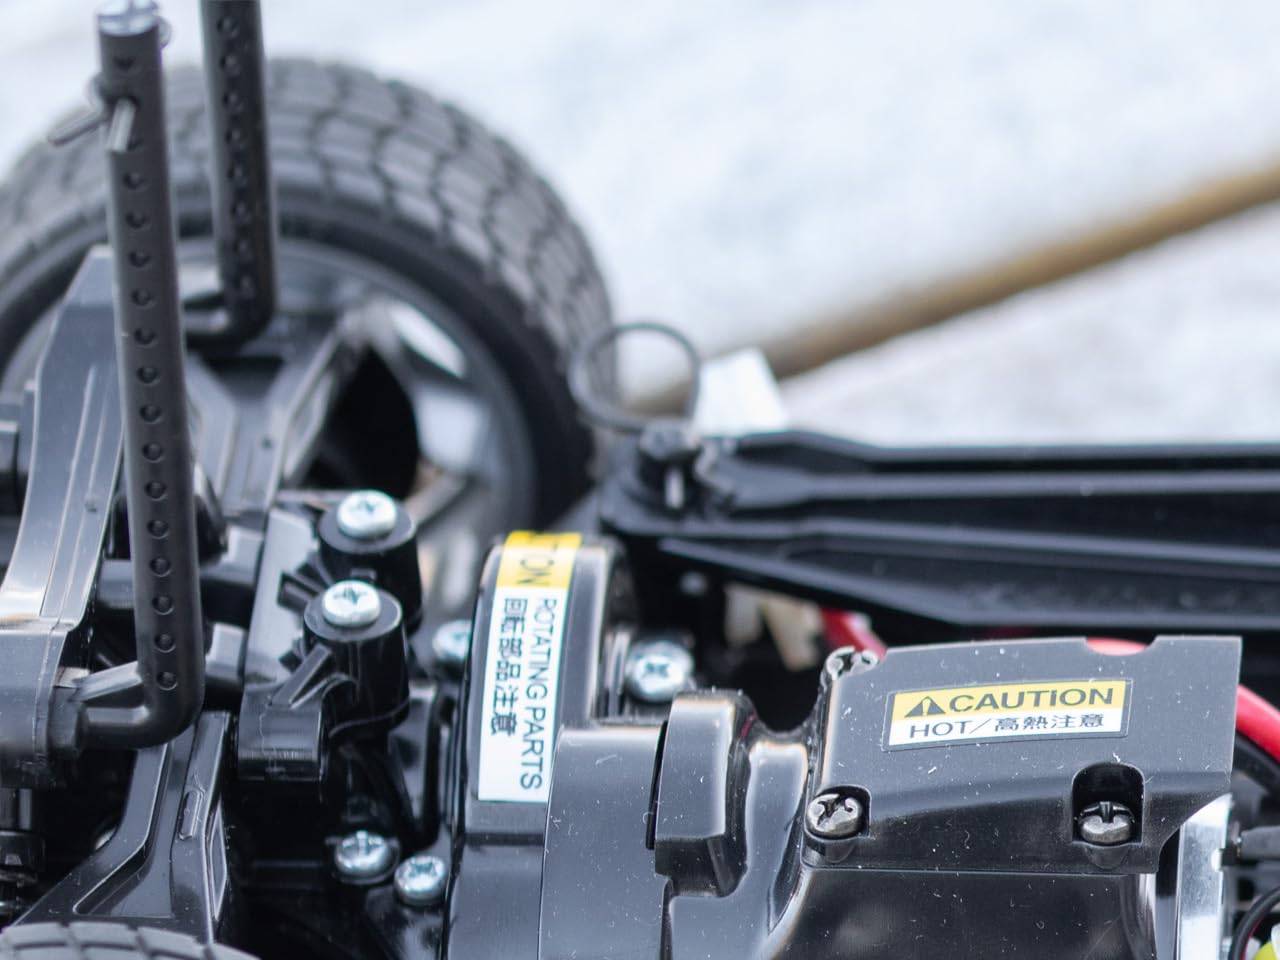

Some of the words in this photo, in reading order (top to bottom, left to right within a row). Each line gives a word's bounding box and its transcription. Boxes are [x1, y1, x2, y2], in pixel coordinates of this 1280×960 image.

[490, 598, 528, 736] 回転部品注意
[526, 598, 557, 700] ROTATING
[949, 688, 1113, 712] CAUTION
[520, 707, 546, 790] PARTS
